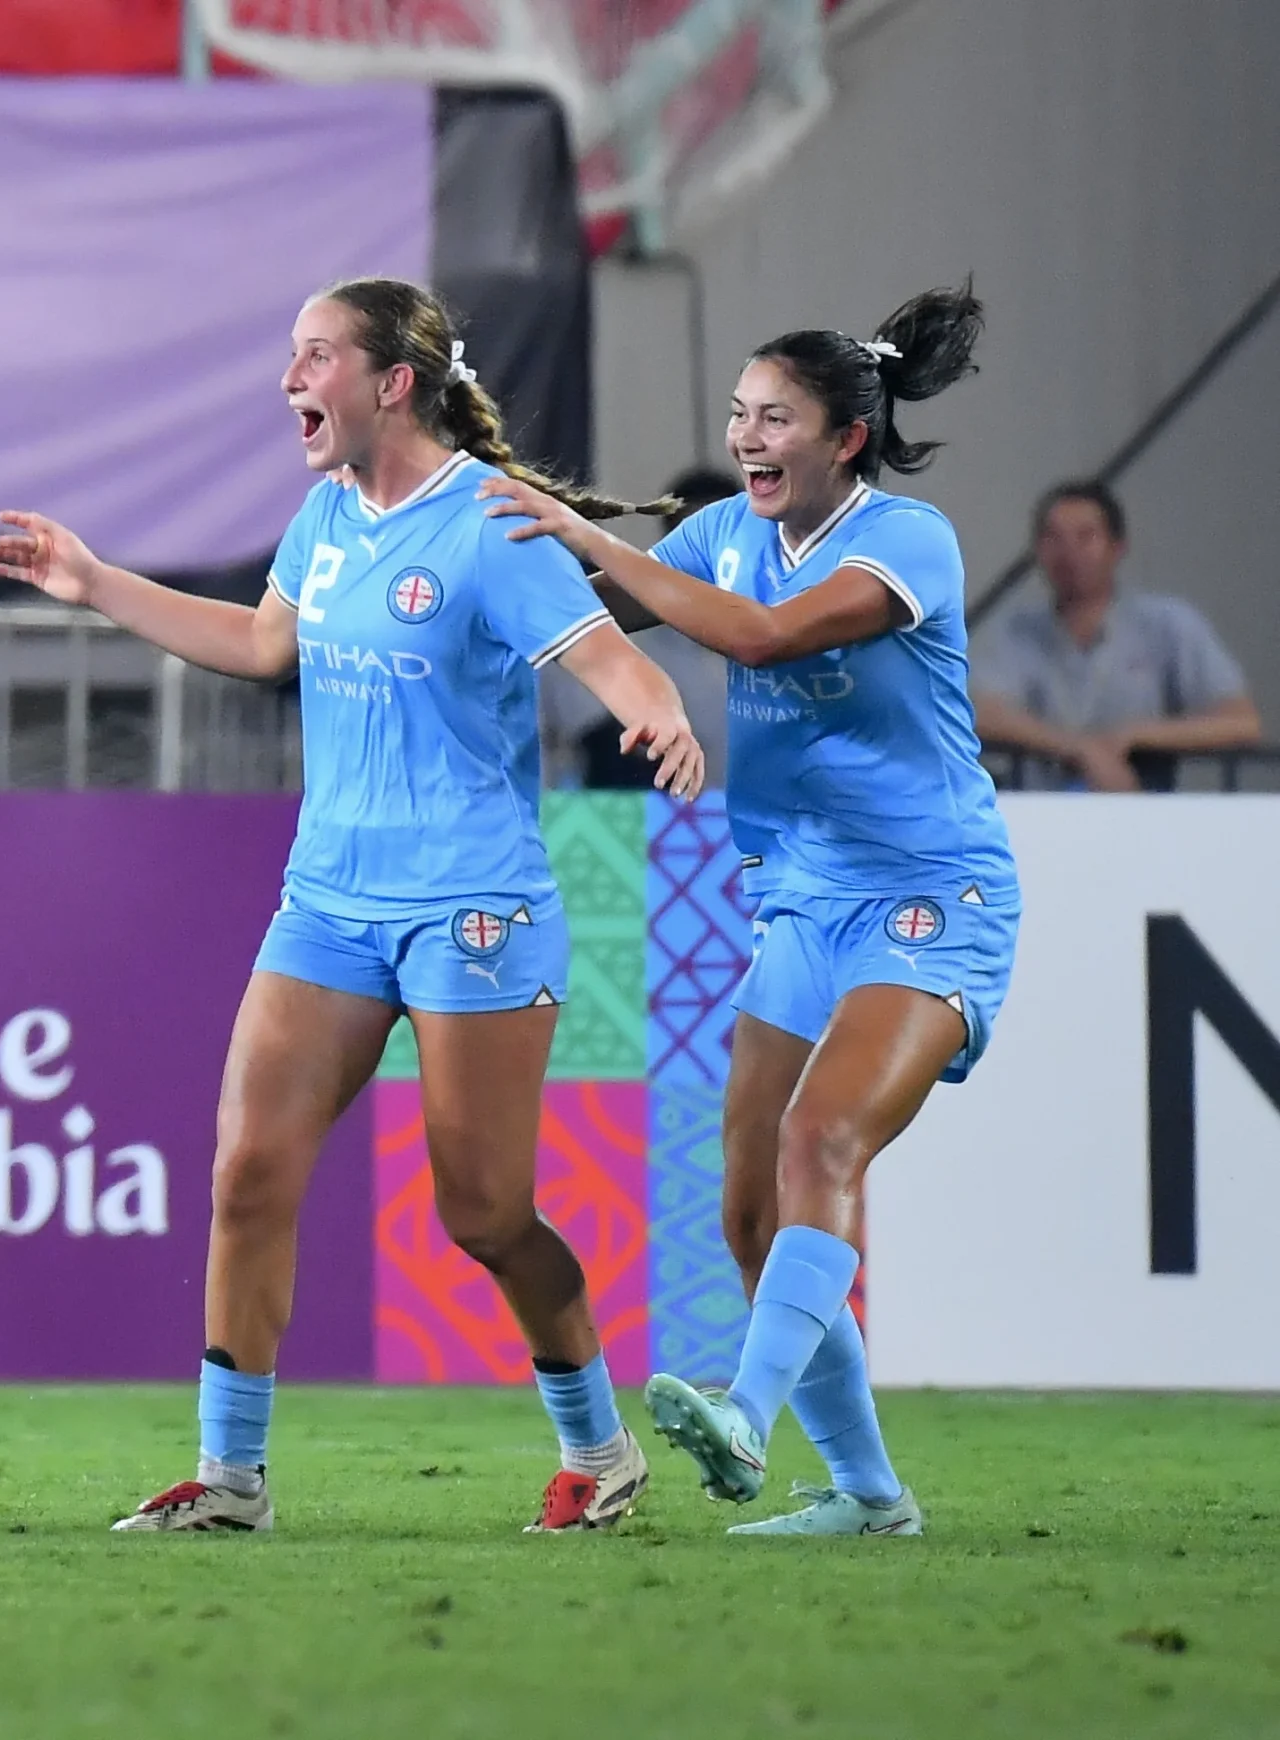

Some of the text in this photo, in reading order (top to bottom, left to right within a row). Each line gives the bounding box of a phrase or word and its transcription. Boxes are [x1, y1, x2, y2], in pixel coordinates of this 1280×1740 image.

[299, 543, 346, 624] 2
[315, 677, 392, 704] AIRWAYS
[727, 698, 818, 722] AIRWAYS
